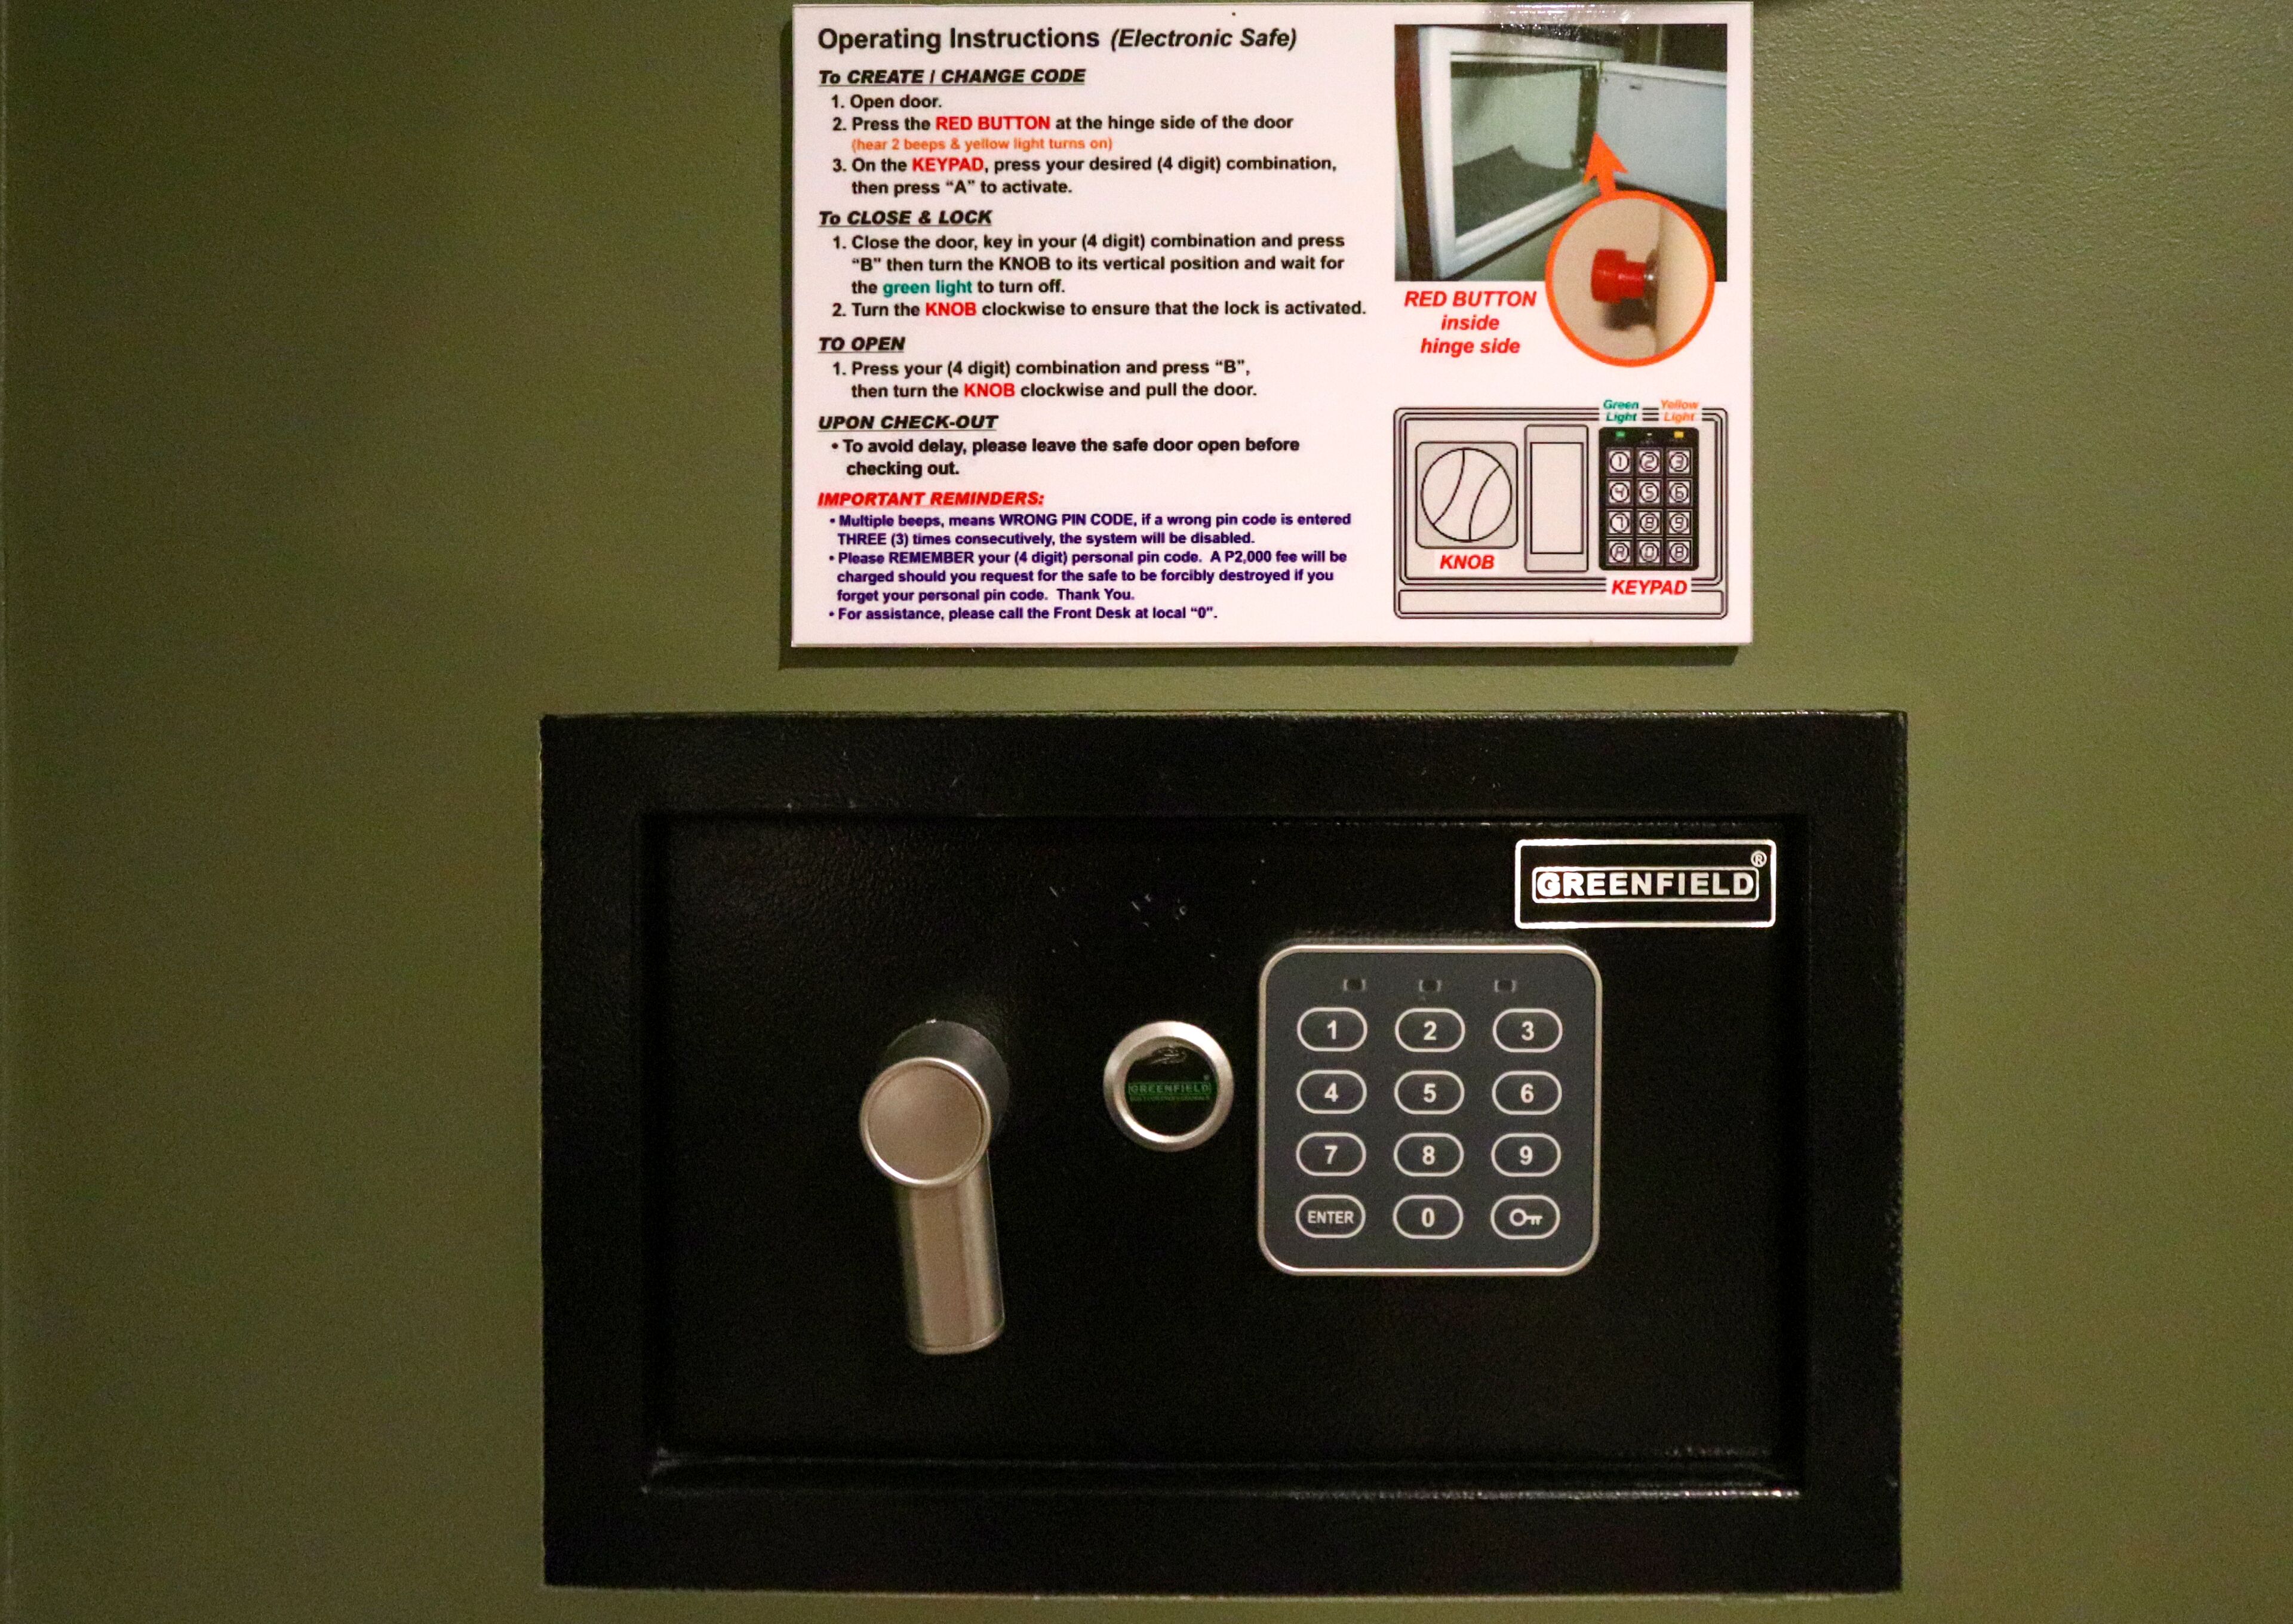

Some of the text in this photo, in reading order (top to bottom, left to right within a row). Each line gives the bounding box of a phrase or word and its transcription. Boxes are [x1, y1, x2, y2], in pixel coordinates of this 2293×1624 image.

[817, 26, 1297, 54] Operating Instructions (Electronic Safe)
[818, 69, 841, 84] To
[847, 69, 925, 84] CREATE
[940, 68, 1026, 84] CHANGE
[1030, 68, 1087, 84] CODE
[831, 93, 942, 111] 1. Open door.
[832, 114, 1294, 134] 2. Press the RED BUTTON at the hinge side of the door
[850, 137, 889, 154] (hear
[890, 137, 900, 151] 2
[902, 137, 947, 153] beeps
[964, 137, 1010, 153] yellow
[1013, 137, 1045, 153] light
[1048, 138, 1086, 150] turns
[1089, 137, 1114, 152] on)
[819, 210, 841, 224] To
[846, 210, 912, 224] CLOSE
[938, 209, 994, 224] LOCK
[851, 278, 1065, 298] the green light to turn off.
[1404, 290, 1537, 307] RED BUTTON
[1440, 314, 1500, 331] inside
[818, 336, 906, 351] TO OPEN
[1420, 337, 1521, 358] hinge side
[832, 361, 847, 376] 1.
[851, 360, 900, 376] Press
[903, 364, 943, 380] your
[947, 360, 963, 379] (4
[967, 359, 1011, 379] digit)
[1015, 359, 1121, 376] combination
[1126, 359, 1158, 375] and
[1162, 362, 1210, 378] press
[1603, 399, 1639, 410] Green
[1661, 399, 1699, 410] Yellow
[818, 414, 1000, 429] UPON CHECK-OUT
[1606, 412, 1637, 425] Light
[1664, 412, 1696, 425] Light
[841, 436, 1300, 457] To avoid delay, please leave the safe door open before
[846, 460, 960, 480] checking out.
[1644, 454, 1655, 469] 2
[1674, 454, 1685, 469] 3
[818, 491, 1045, 506] IMPORTANT REMINDERS:
[1645, 485, 1655, 500] 5
[1674, 485, 1685, 500] 6
[838, 513, 1352, 530] Multiple beeps, means WRONG PIN CODE, if a wrong pin code is entered
[1615, 516, 1624, 528] 7
[1674, 516, 1684, 529] 9
[837, 531, 1255, 548] THREE (3) times consecutively, the system will be disabled.
[838, 550, 1347, 567] Please REMEMBER your (4 digit) personal pin code. A P2,000 fee will be
[1439, 553, 1495, 570] KNOB
[1611, 579, 1688, 596] KEYPAD
[838, 607, 863, 621] For
[865, 607, 945, 622] assistance,
[948, 606, 995, 623] please
[998, 606, 1024, 620] call
[1026, 607, 1050, 620] the
[1053, 606, 1092, 619] Front
[1095, 606, 1131, 620] Desk
[1135, 607, 1149, 619] at
[1152, 606, 1187, 619] local
[1536, 871, 1754, 897] GREENFIELD
[1327, 1020, 1535, 1041] 1 2 3
[1129, 1084, 1209, 1094] GREENFIELD
[1324, 1082, 1534, 1103] 4 5 6
[1324, 1145, 1533, 1165] 7 8 9
[1307, 1207, 1435, 1228] ENTER 0
